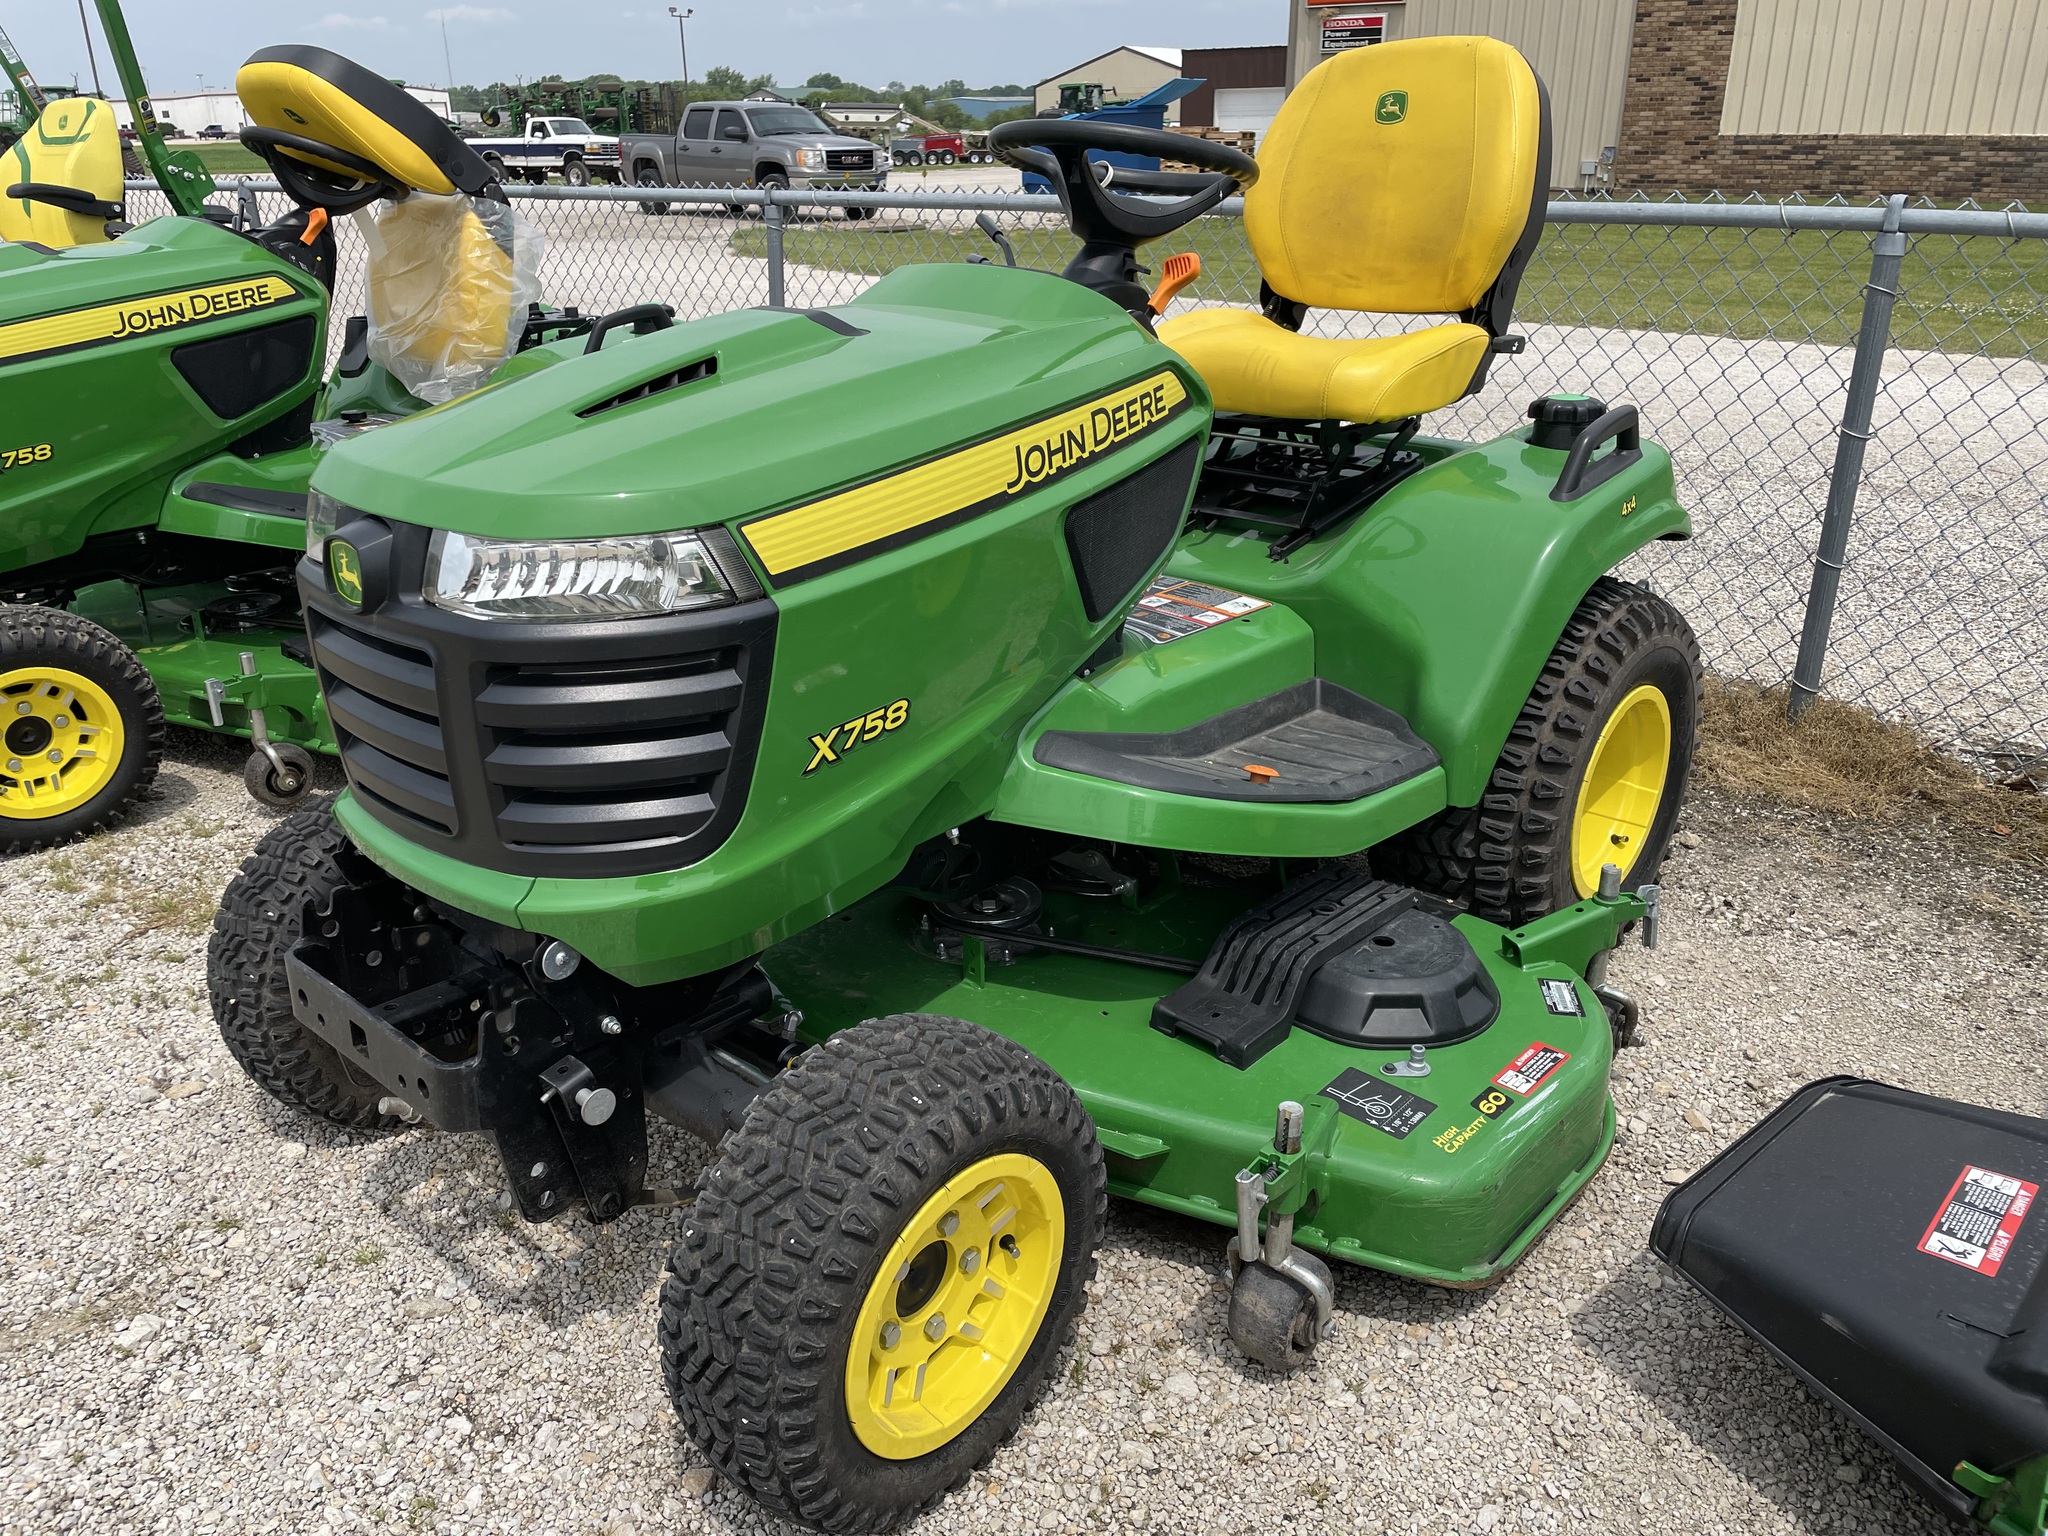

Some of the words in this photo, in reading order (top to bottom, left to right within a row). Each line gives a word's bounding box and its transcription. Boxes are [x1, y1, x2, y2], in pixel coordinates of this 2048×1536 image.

[1325, 20, 1365, 28] HONDA
[1324, 40, 1369, 48] Equipment
[112, 302, 187, 337] JOHN
[189, 284, 273, 318] DEERE
[1007, 424, 1088, 492] JOHN
[1091, 384, 1168, 450] DEERE
[0, 444, 52, 469] 758
[1622, 495, 1637, 516] 4x4
[803, 698, 910, 774] X758
[1479, 1091, 1506, 1114] 60
[1432, 1125, 1460, 1148] HIGH
[1444, 1115, 1487, 1153] CAPACITY
[1986, 1238, 2010, 1262] PELIGRO
